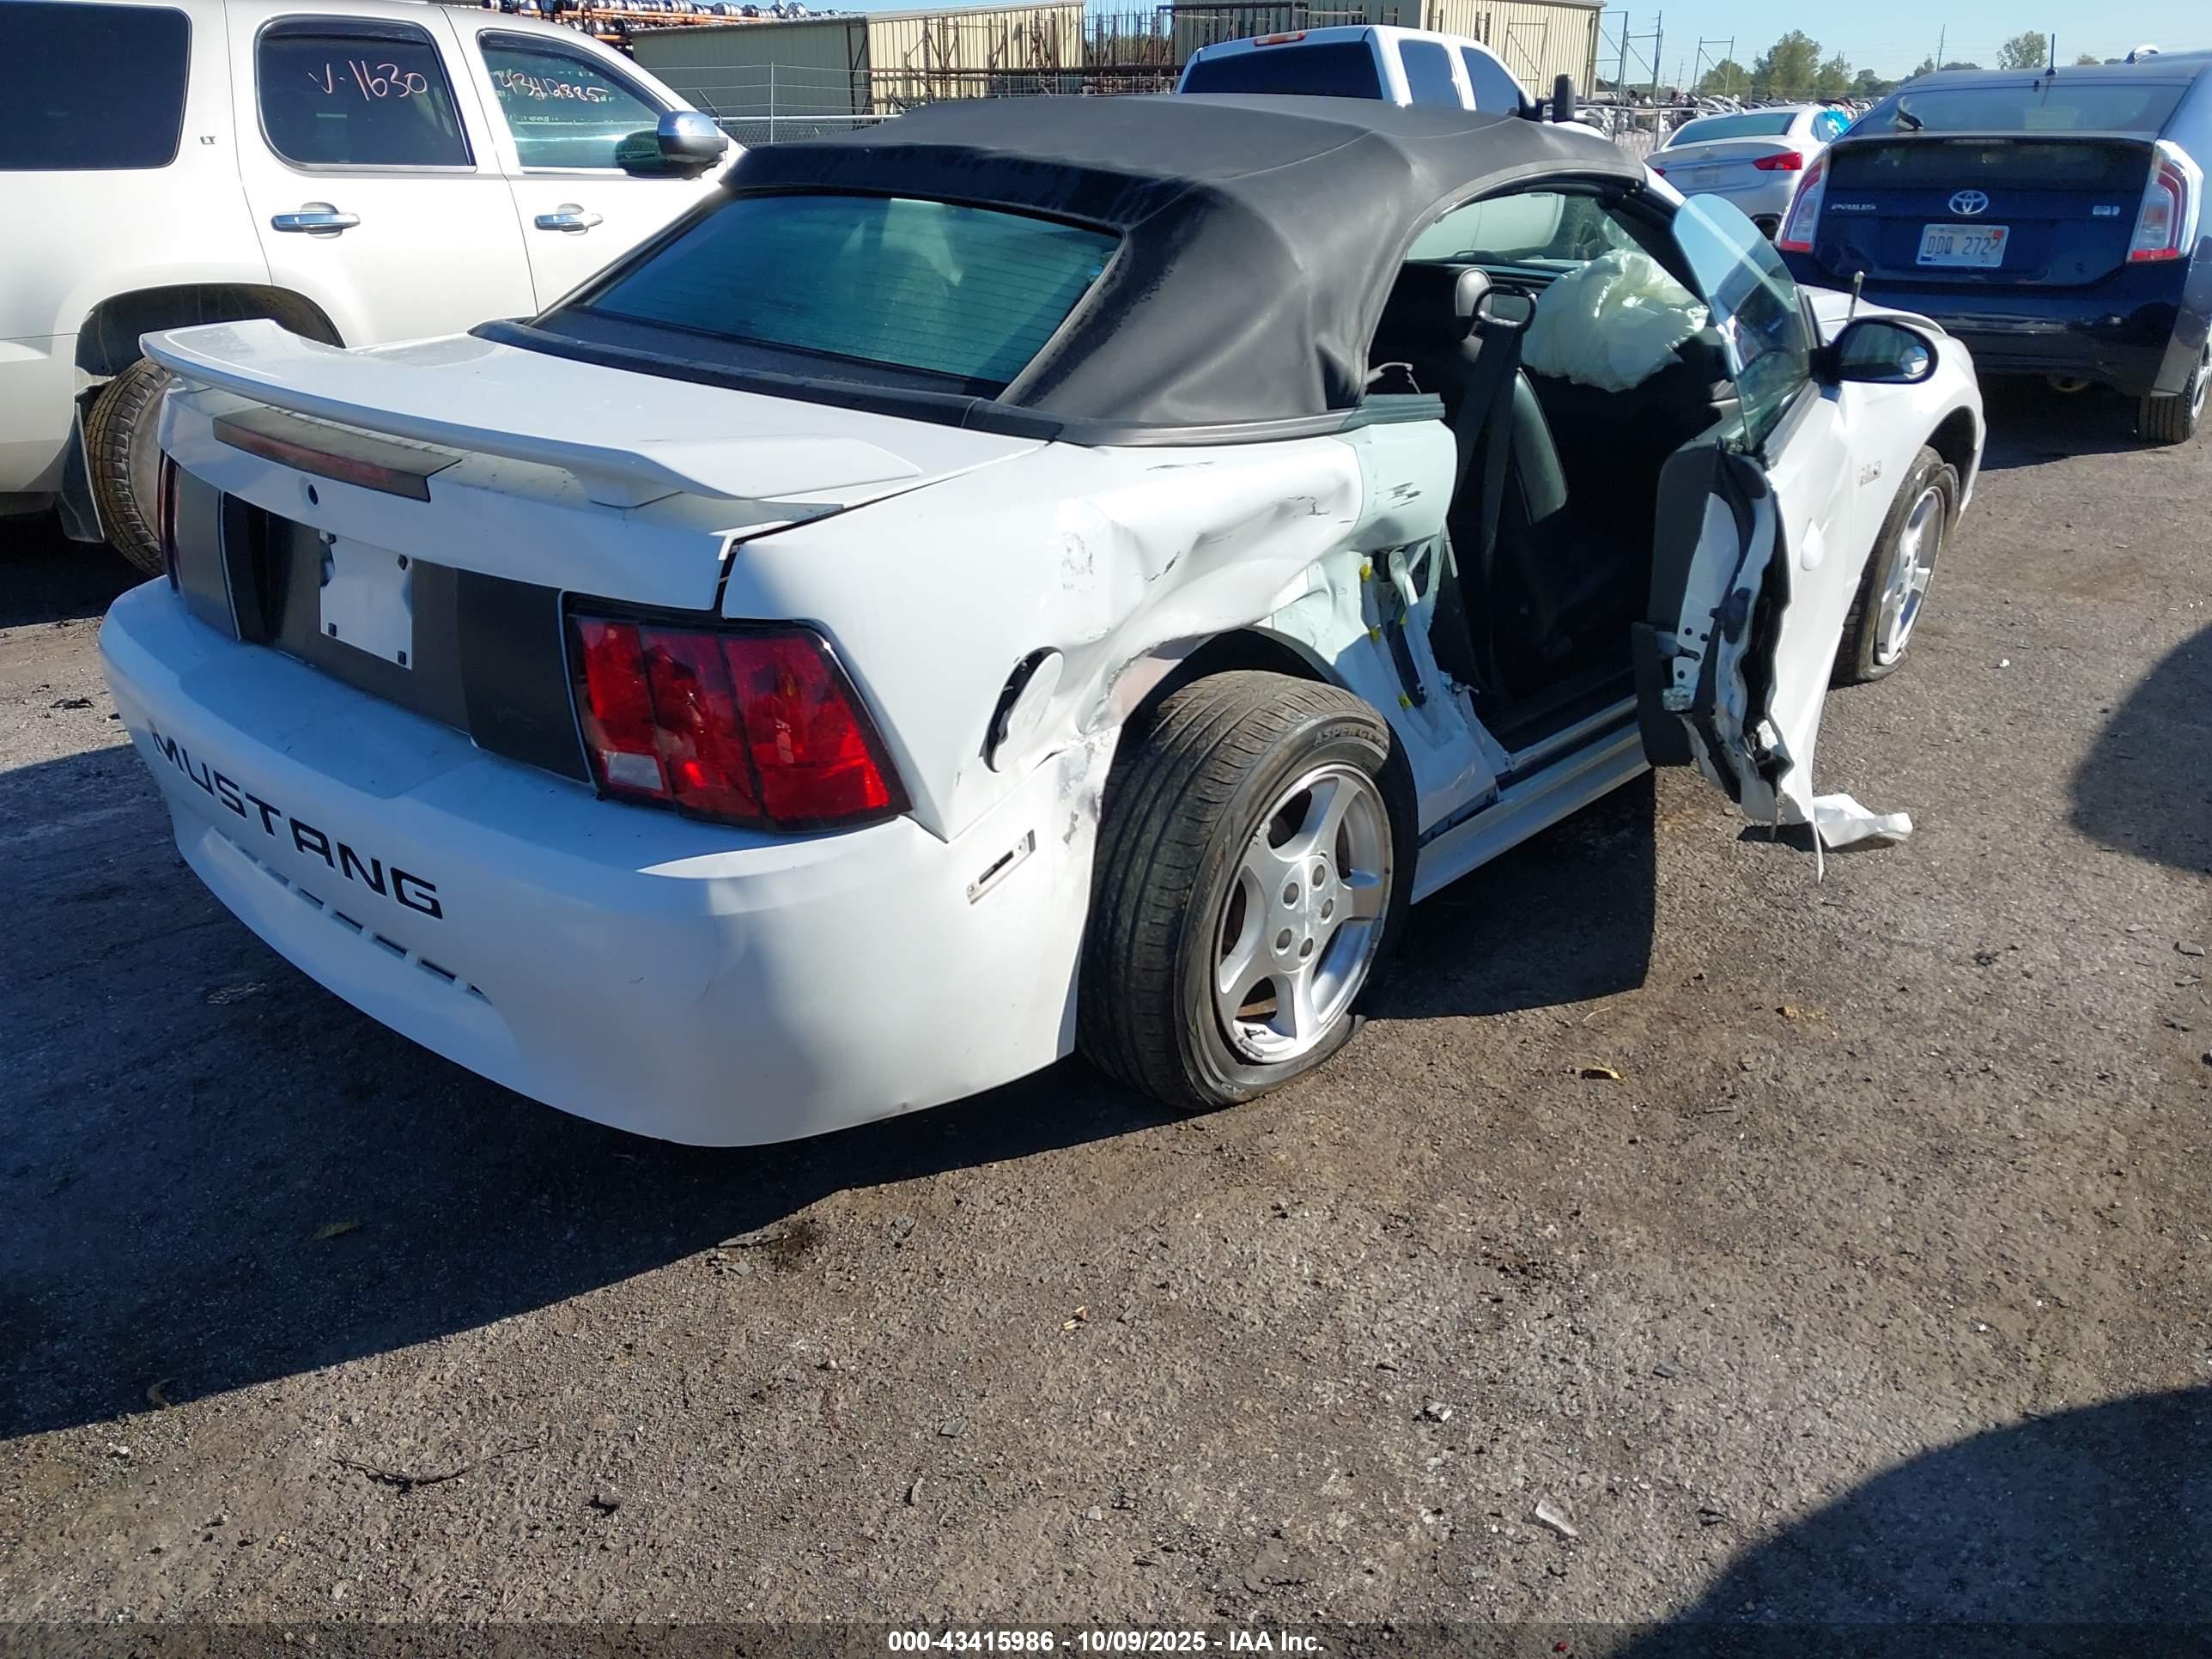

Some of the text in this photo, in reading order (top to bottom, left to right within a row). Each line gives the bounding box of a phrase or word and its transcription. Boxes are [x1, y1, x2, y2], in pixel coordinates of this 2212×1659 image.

[199, 136, 216, 145] LT
[1312, 725, 1359, 746] ASPEN
[147, 719, 443, 920] MUSTANG
